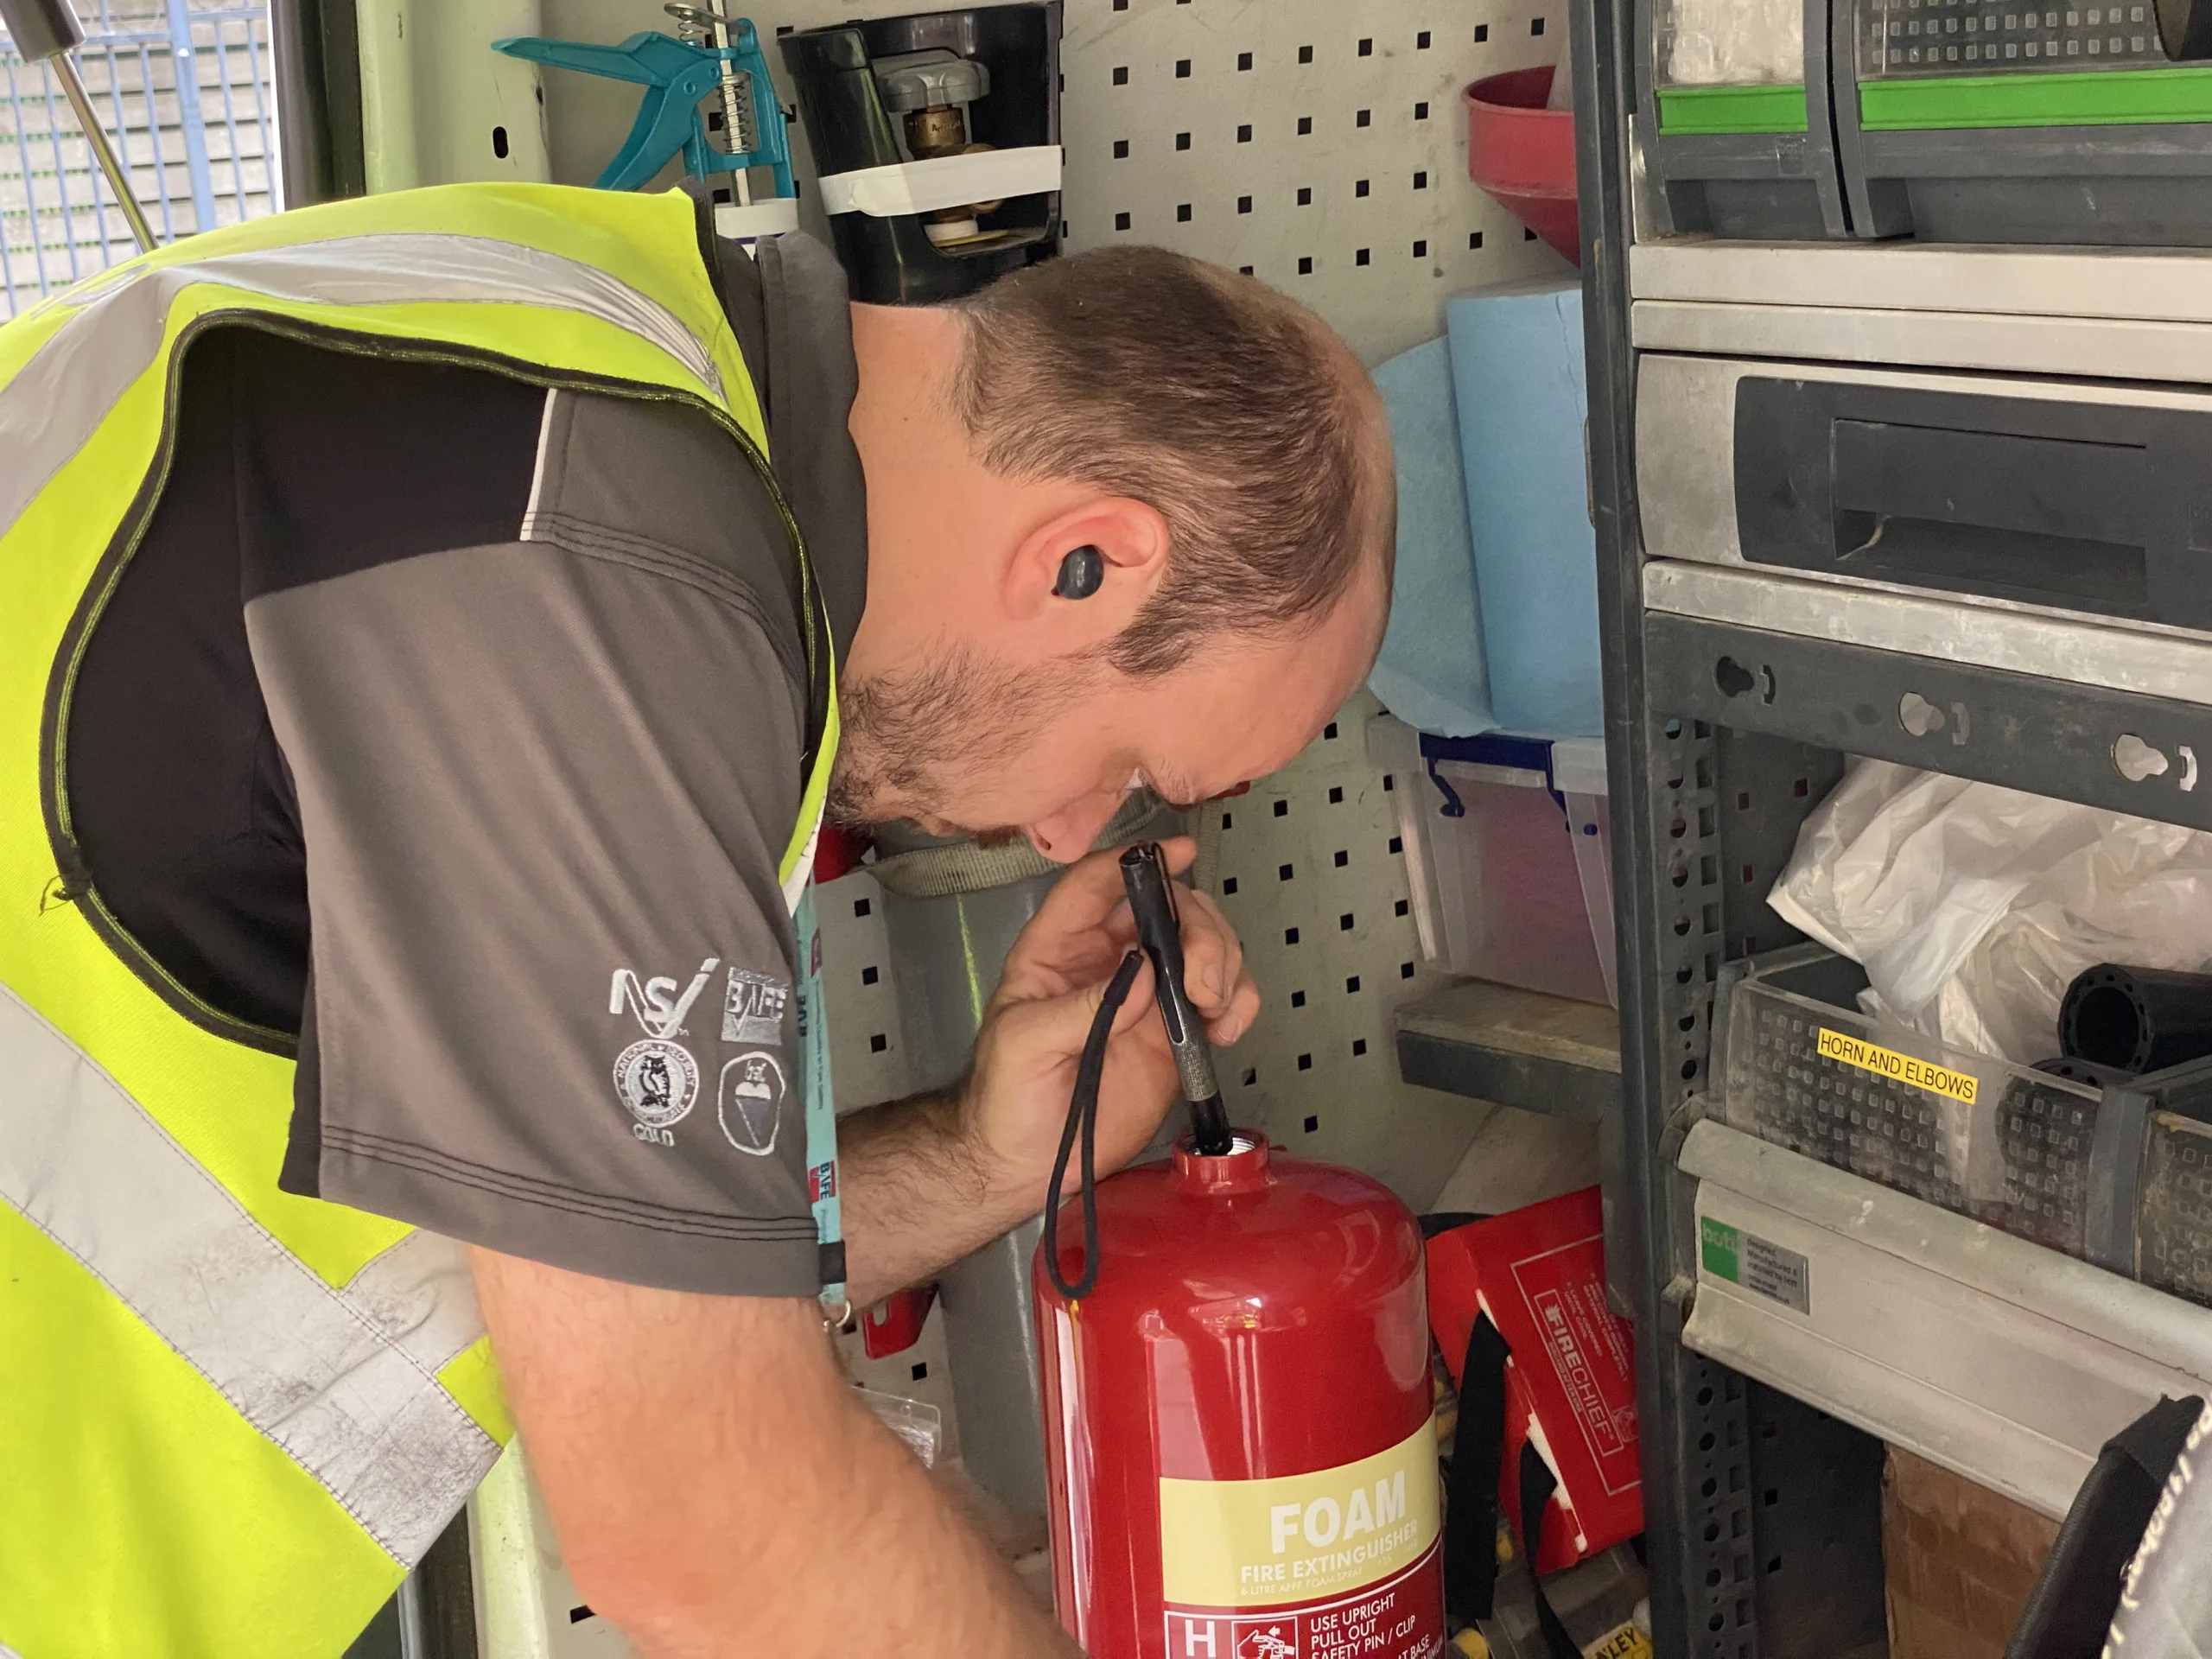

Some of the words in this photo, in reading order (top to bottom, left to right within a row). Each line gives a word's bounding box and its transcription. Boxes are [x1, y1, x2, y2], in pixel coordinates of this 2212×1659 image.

[1821, 1032, 1865, 1064] HORN
[1868, 1050, 1901, 1075] AND
[1905, 1062, 1974, 1099] ELBOWS
[1548, 1310, 1611, 1436] FIRECHIEF
[1270, 1469, 1406, 1554] FOAM
[1241, 1563, 1286, 1583] FIRE
[1294, 1519, 1417, 1578] EXTINGUISHER
[1251, 1584, 1275, 1594] LITRE
[1306, 1576, 1334, 1590] FOAM
[1311, 1614, 1338, 1632] USE
[1343, 1592, 1395, 1625] UPRIGHT
[1185, 1619, 1216, 1658] H
[1311, 1630, 1344, 1649] PULL
[1348, 1618, 1376, 1640] OUT
[1364, 1632, 1384, 1652] PIN
[1395, 1615, 1415, 1637] CLIP
[1410, 1634, 1430, 1657] BASE
